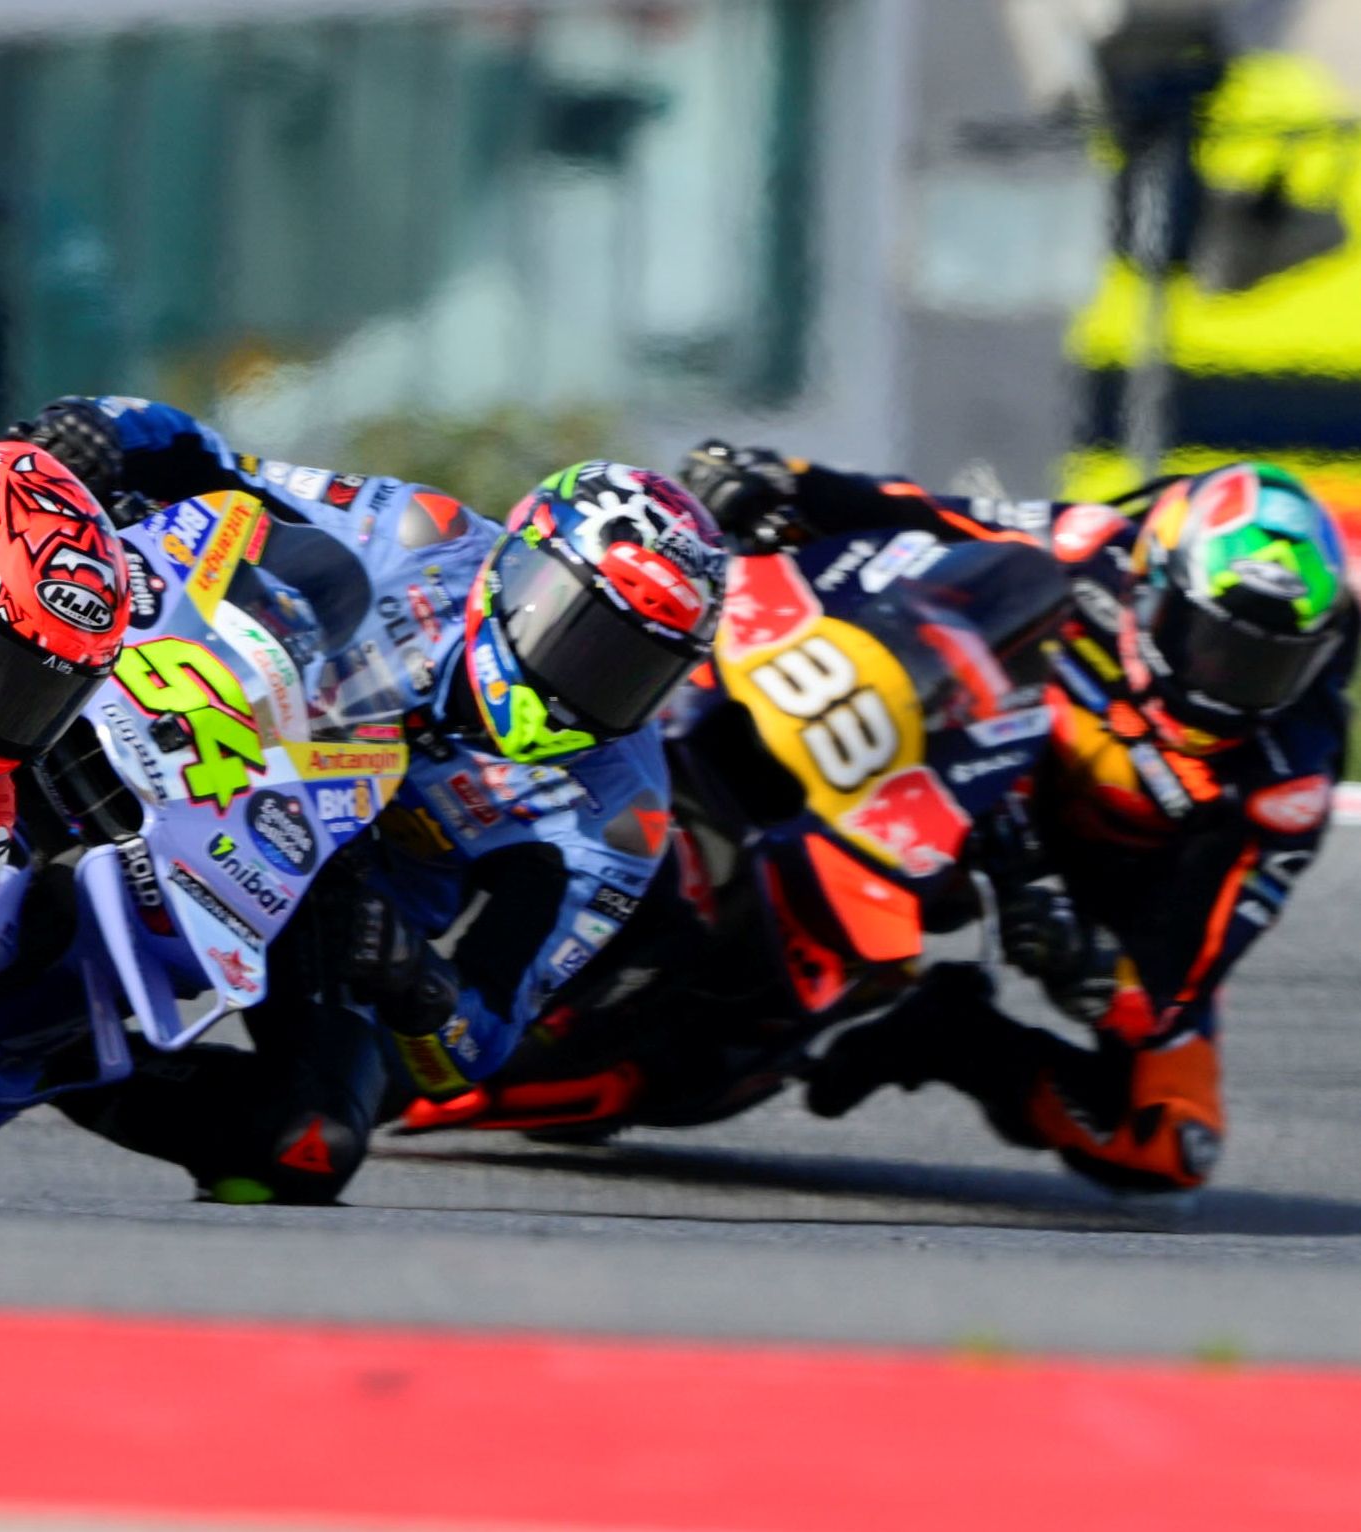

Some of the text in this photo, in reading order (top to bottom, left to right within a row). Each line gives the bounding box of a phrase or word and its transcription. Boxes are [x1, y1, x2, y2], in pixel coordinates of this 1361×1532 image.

[47, 586, 109, 625] HJC
[111, 636, 268, 820] 54
[748, 634, 900, 794] 33
[309, 749, 401, 774] Antangin
[127, 840, 164, 907] BOLD
